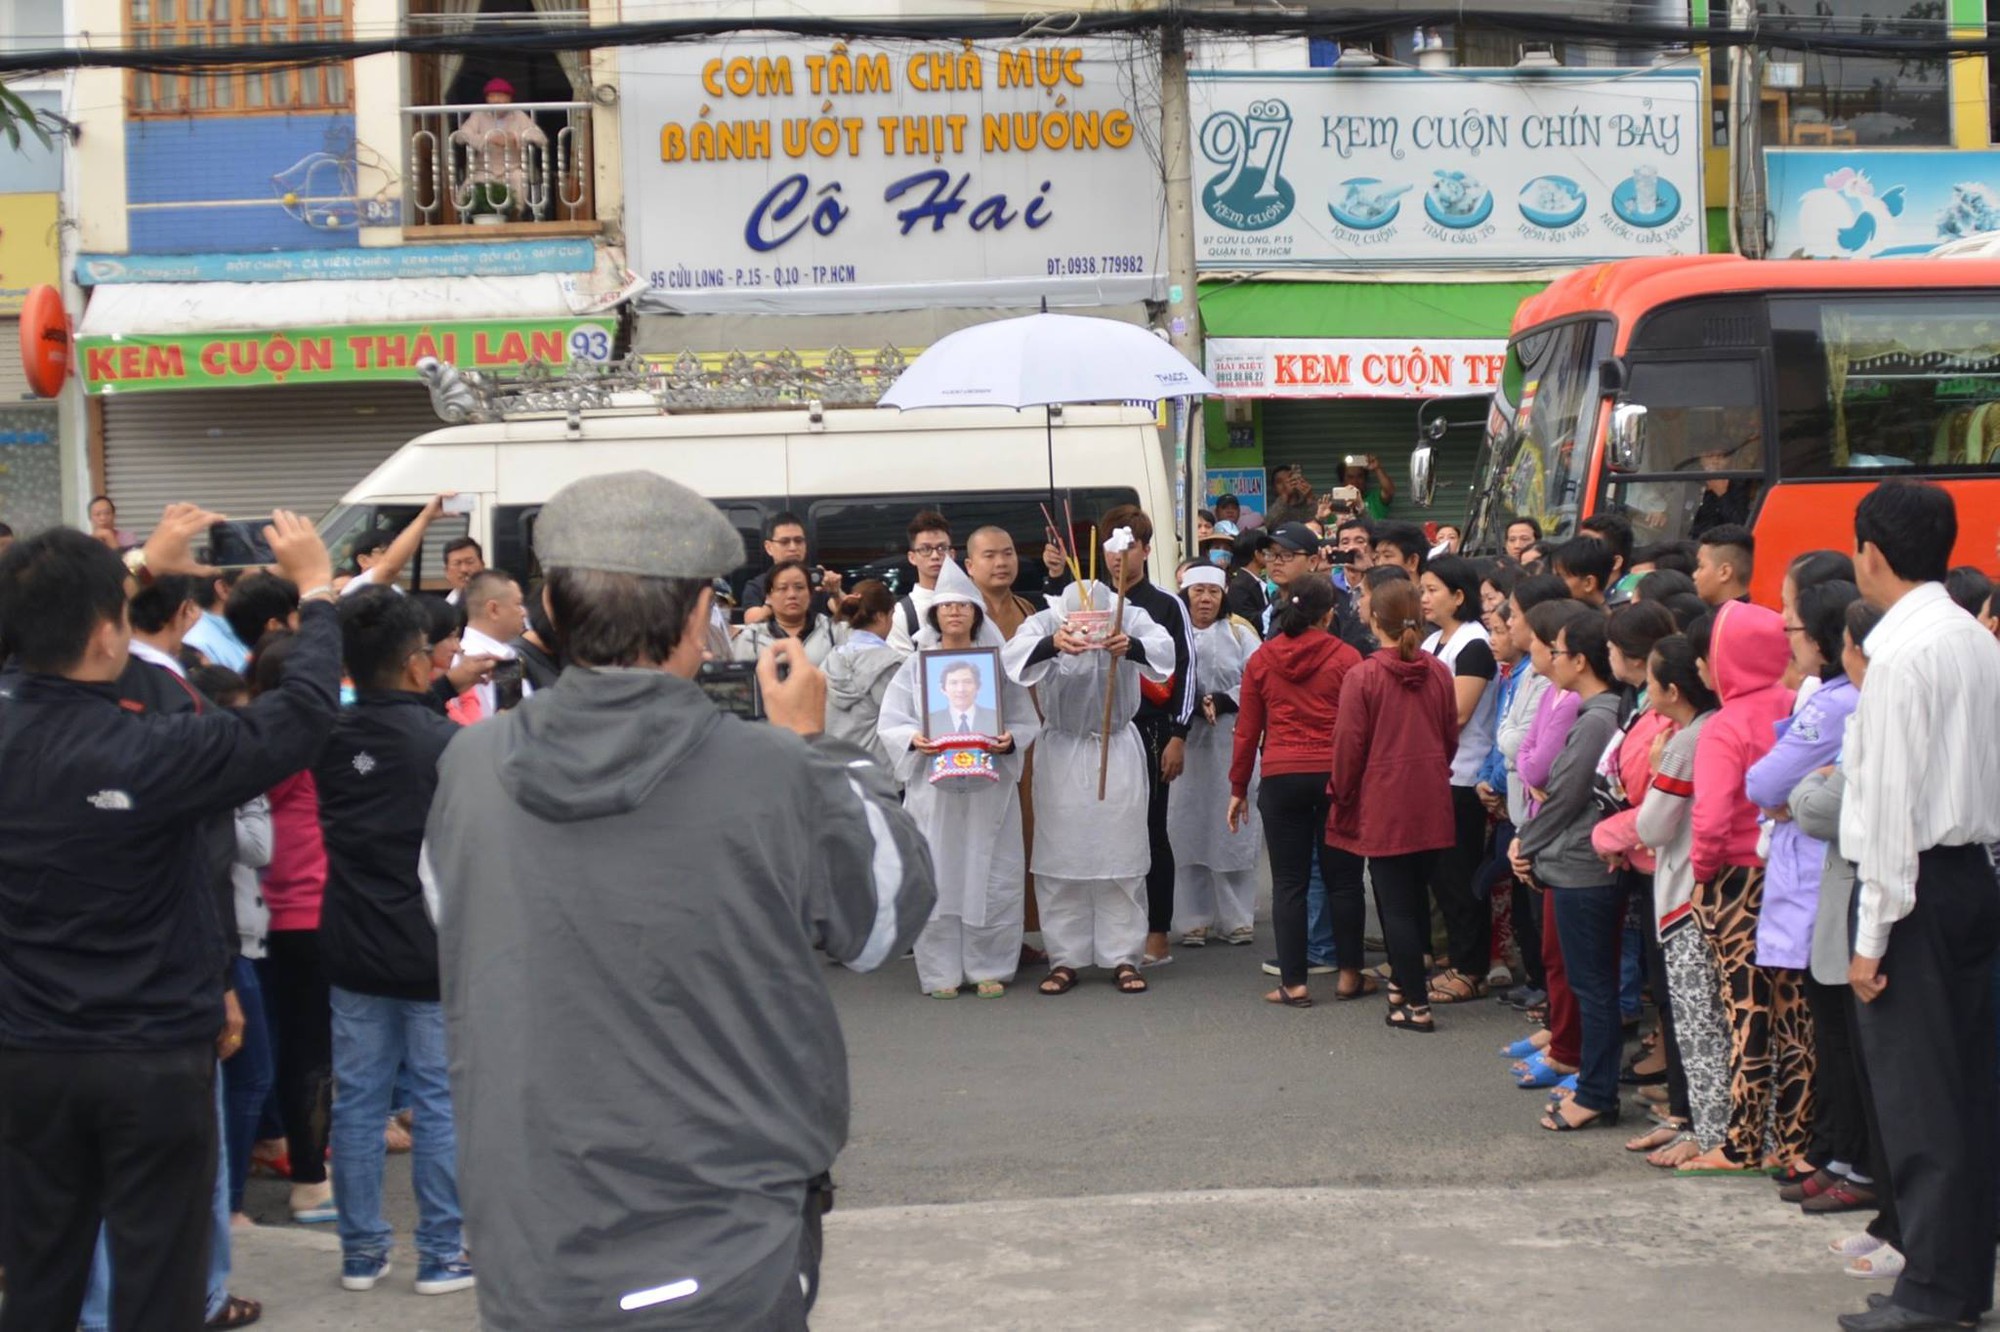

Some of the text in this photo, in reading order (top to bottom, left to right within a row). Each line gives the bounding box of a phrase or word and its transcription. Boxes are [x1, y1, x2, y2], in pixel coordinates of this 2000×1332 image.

[702, 55, 793, 97] CƠM
[997, 46, 1084, 96] MỰC
[660, 93, 1134, 164] BÁNH ƯỚT THỊT NƯỚNG
[1200, 98, 1293, 198] 97
[1321, 96, 1680, 160] KEM CUỘN CHÍN BẢY
[744, 168, 1052, 252] Cô Hai
[1213, 200, 1245, 228] KEM
[650, 270, 665, 289] 95
[695, 269, 723, 287] LONG
[736, 268, 761, 286] P.15
[812, 265, 855, 284] TP.HCM
[86, 326, 563, 383] KEM CUỘN THÁI LAN
[571, 331, 609, 362] 93
[1274, 354, 1350, 385] KEM
[1361, 345, 1453, 392] CUỘN
